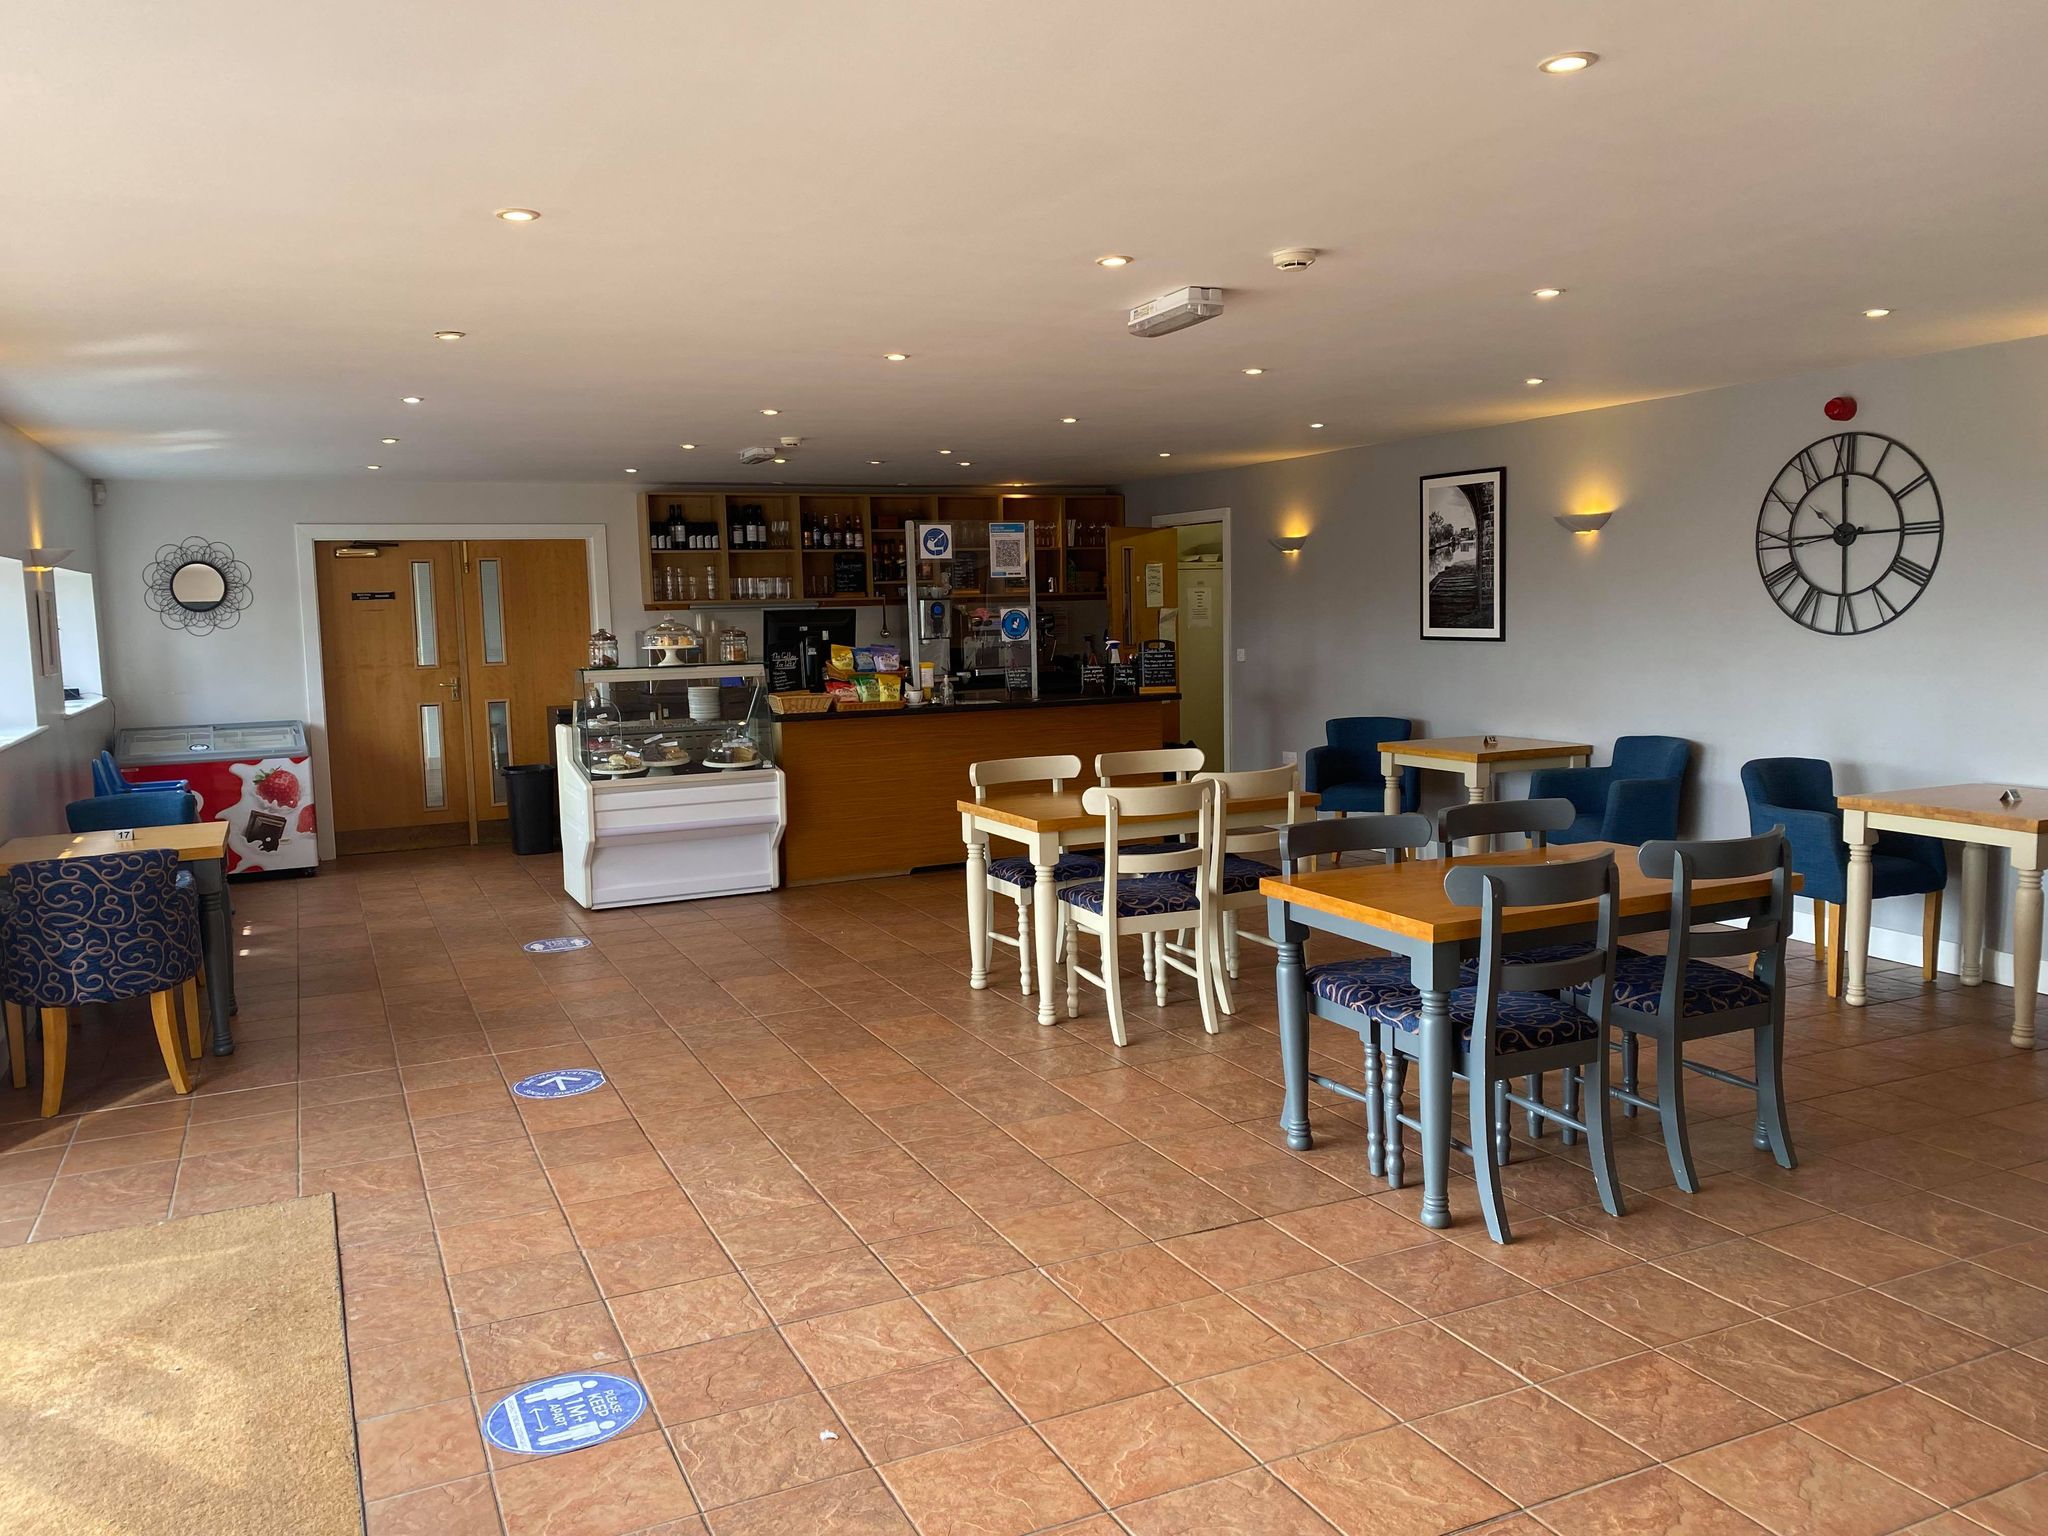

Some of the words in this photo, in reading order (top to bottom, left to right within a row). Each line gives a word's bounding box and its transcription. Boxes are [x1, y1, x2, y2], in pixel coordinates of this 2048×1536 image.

[118, 831, 130, 839] 17
[564, 1396, 589, 1422] 1M+
[587, 1392, 609, 1417] KEEP
[603, 1389, 622, 1414] PLEASE
[548, 1404, 567, 1427] APART
